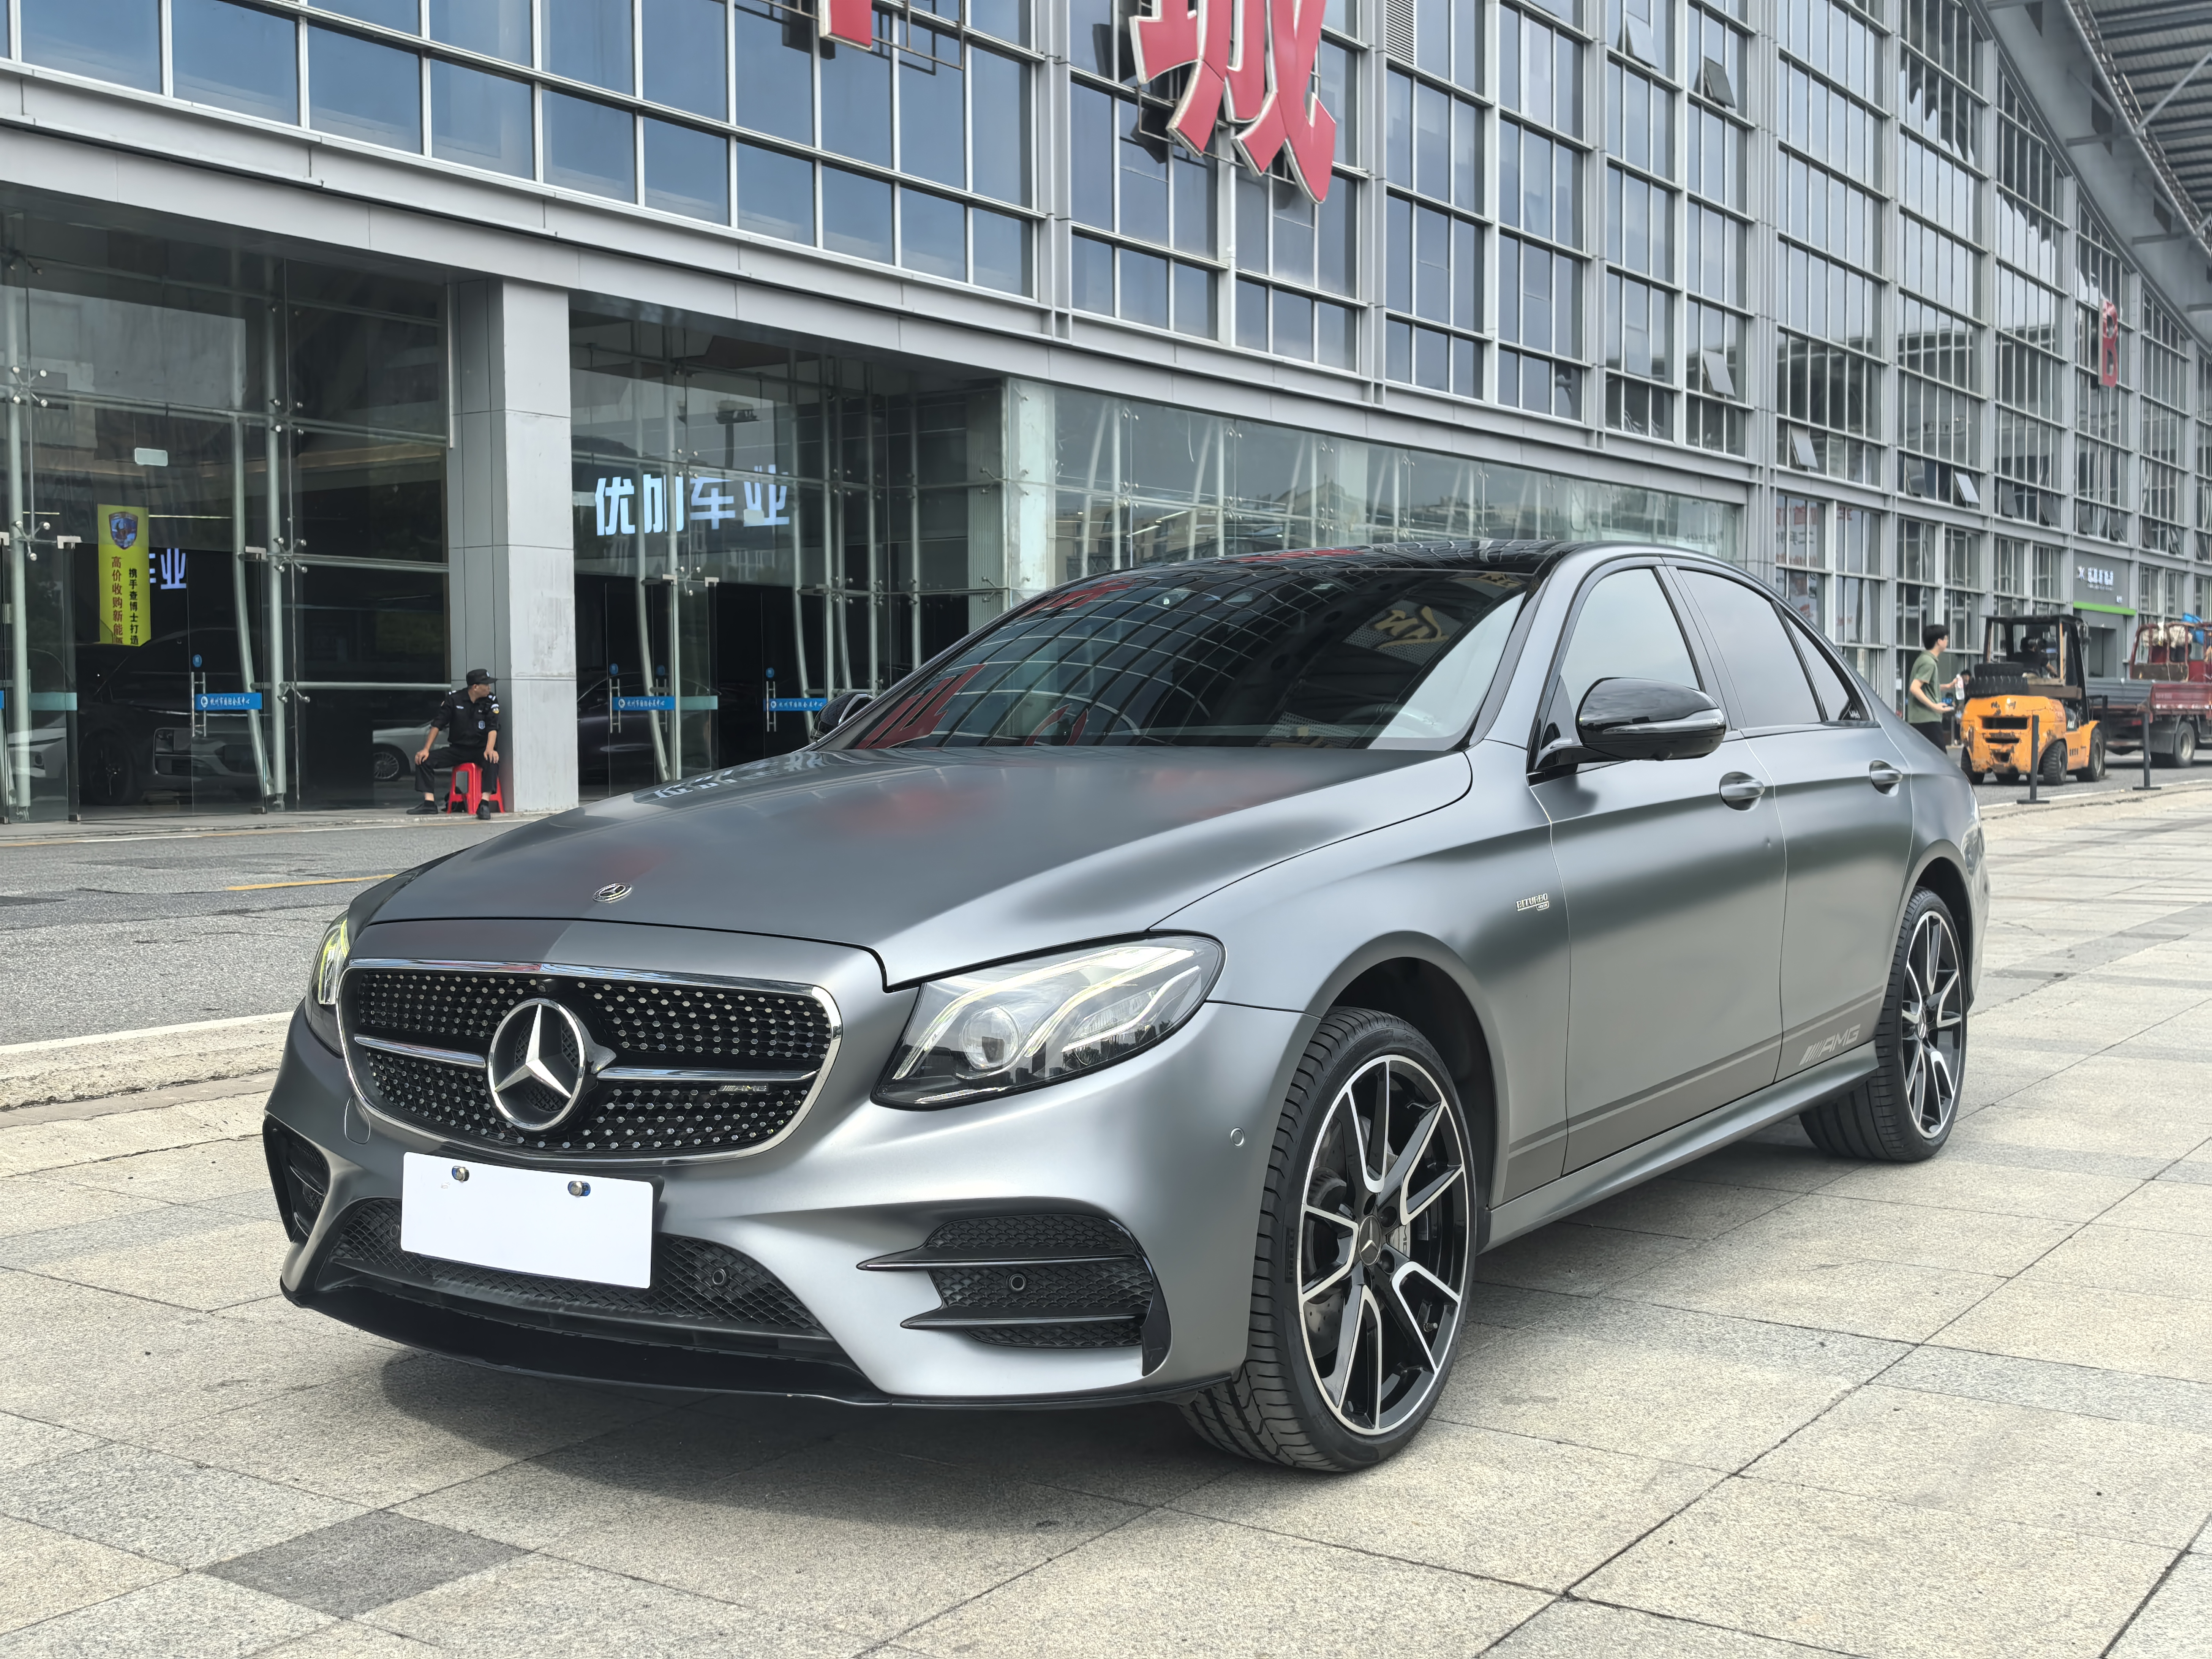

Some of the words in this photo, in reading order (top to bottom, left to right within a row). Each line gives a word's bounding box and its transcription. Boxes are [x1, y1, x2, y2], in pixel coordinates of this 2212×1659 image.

[2100, 299, 2118, 388] B
[595, 464, 790, 536] 优加车业
[1516, 893, 1548, 909] BITURBO
[1814, 1024, 1861, 1060] AMG
